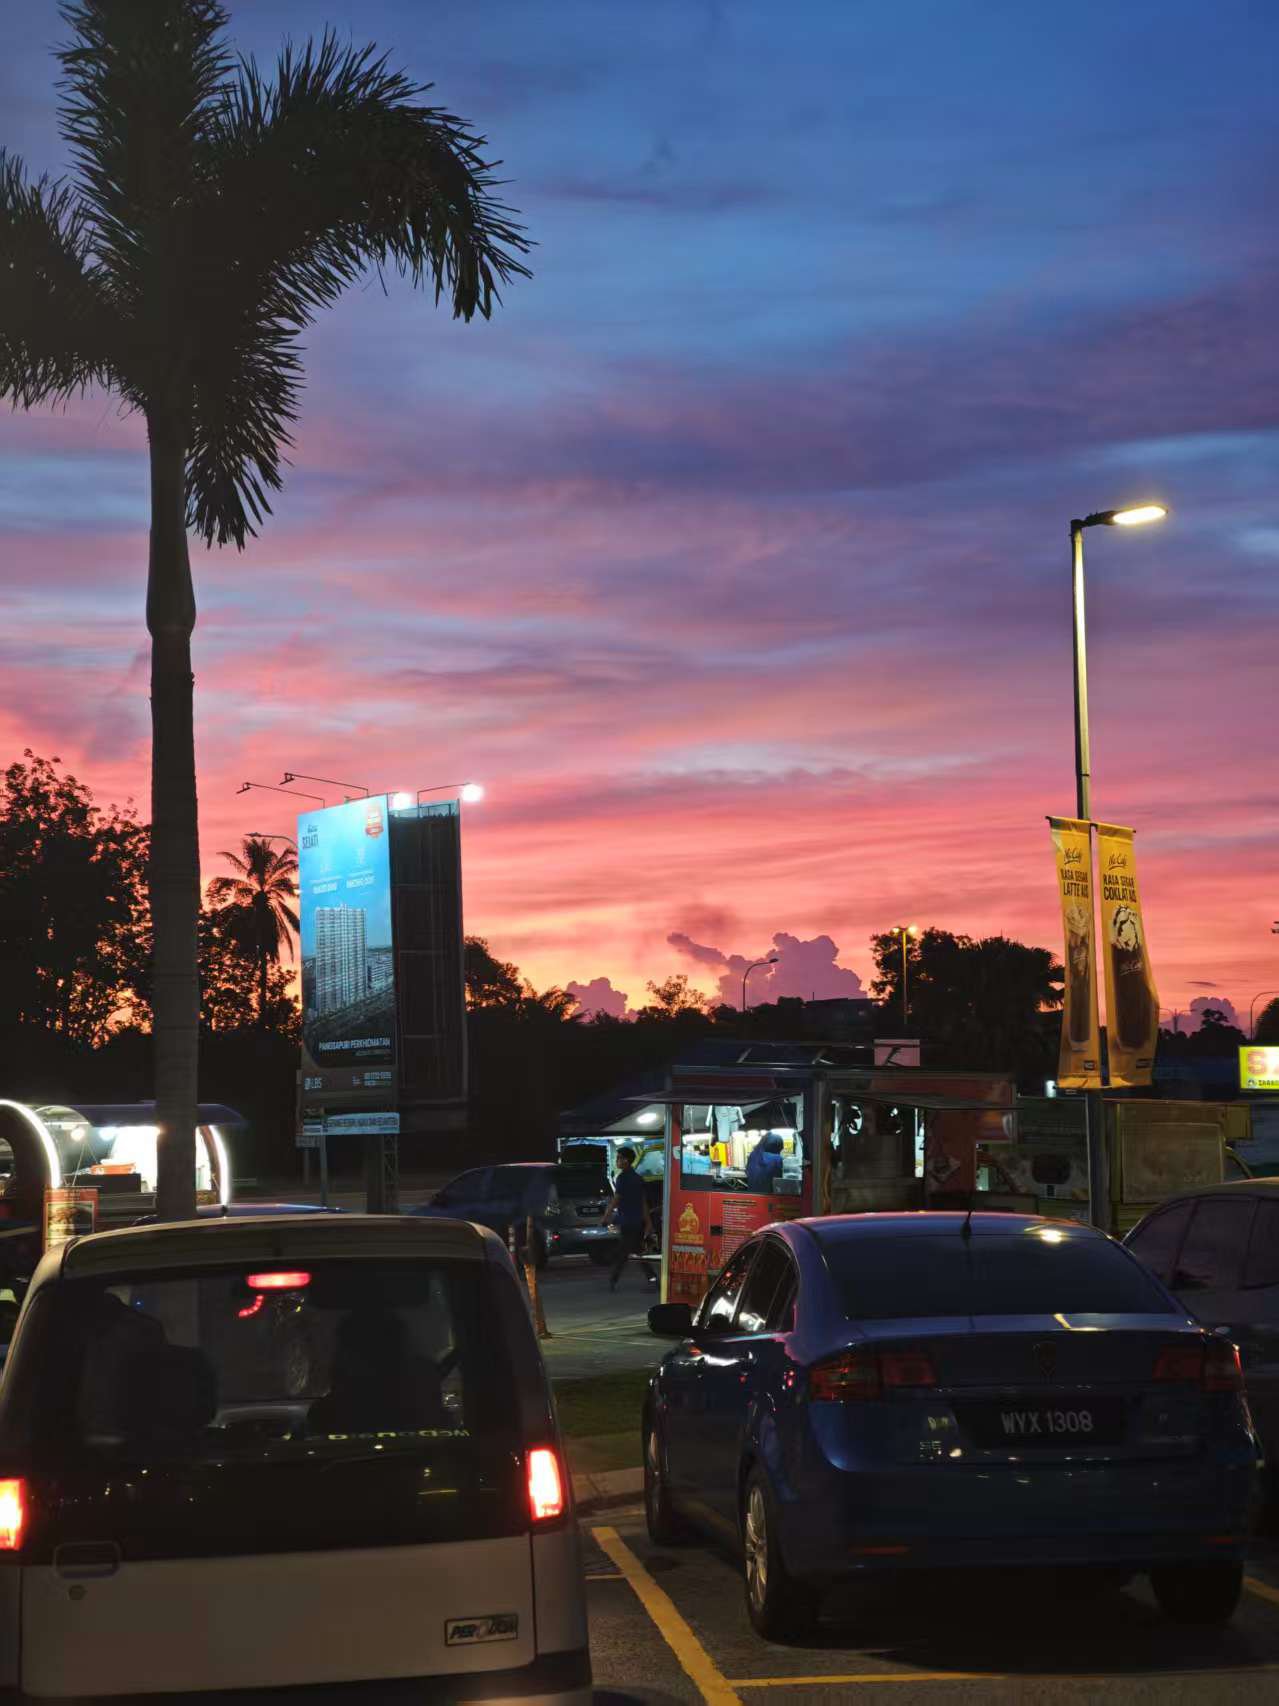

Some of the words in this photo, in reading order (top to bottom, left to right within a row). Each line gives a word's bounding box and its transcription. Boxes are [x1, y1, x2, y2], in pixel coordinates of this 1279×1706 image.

[1064, 882, 1080, 897] LATTE
[1000, 1410, 1042, 1434] WYX
[1047, 1409, 1094, 1433] 1308
